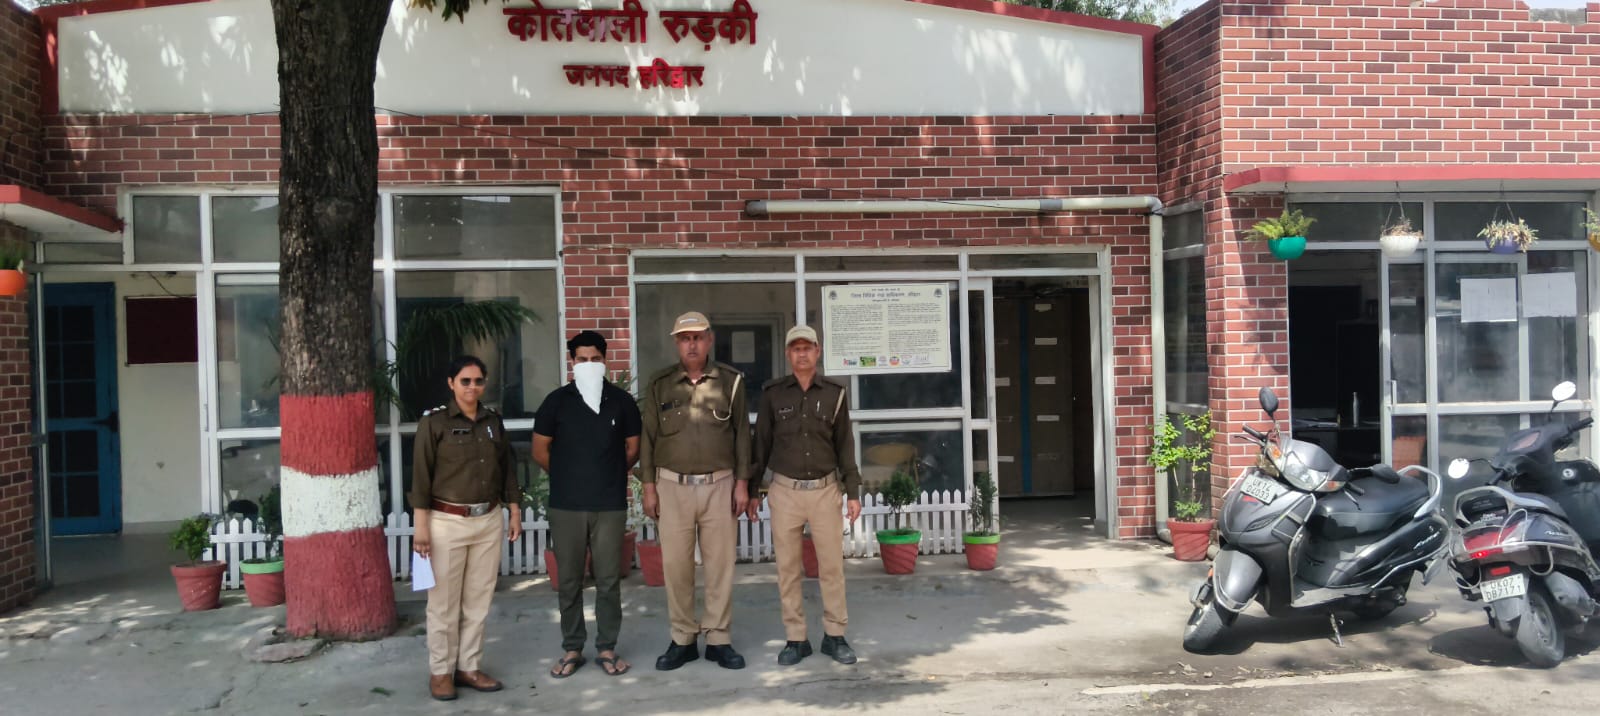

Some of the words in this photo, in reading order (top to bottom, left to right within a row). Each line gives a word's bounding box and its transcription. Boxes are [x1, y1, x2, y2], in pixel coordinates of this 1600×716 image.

[503, 0, 648, 43] कोतवाली
[660, 0, 758, 51] रुड़की
[563, 65, 630, 88] जनपद
[637, 58, 705, 89] हरिद्वार
